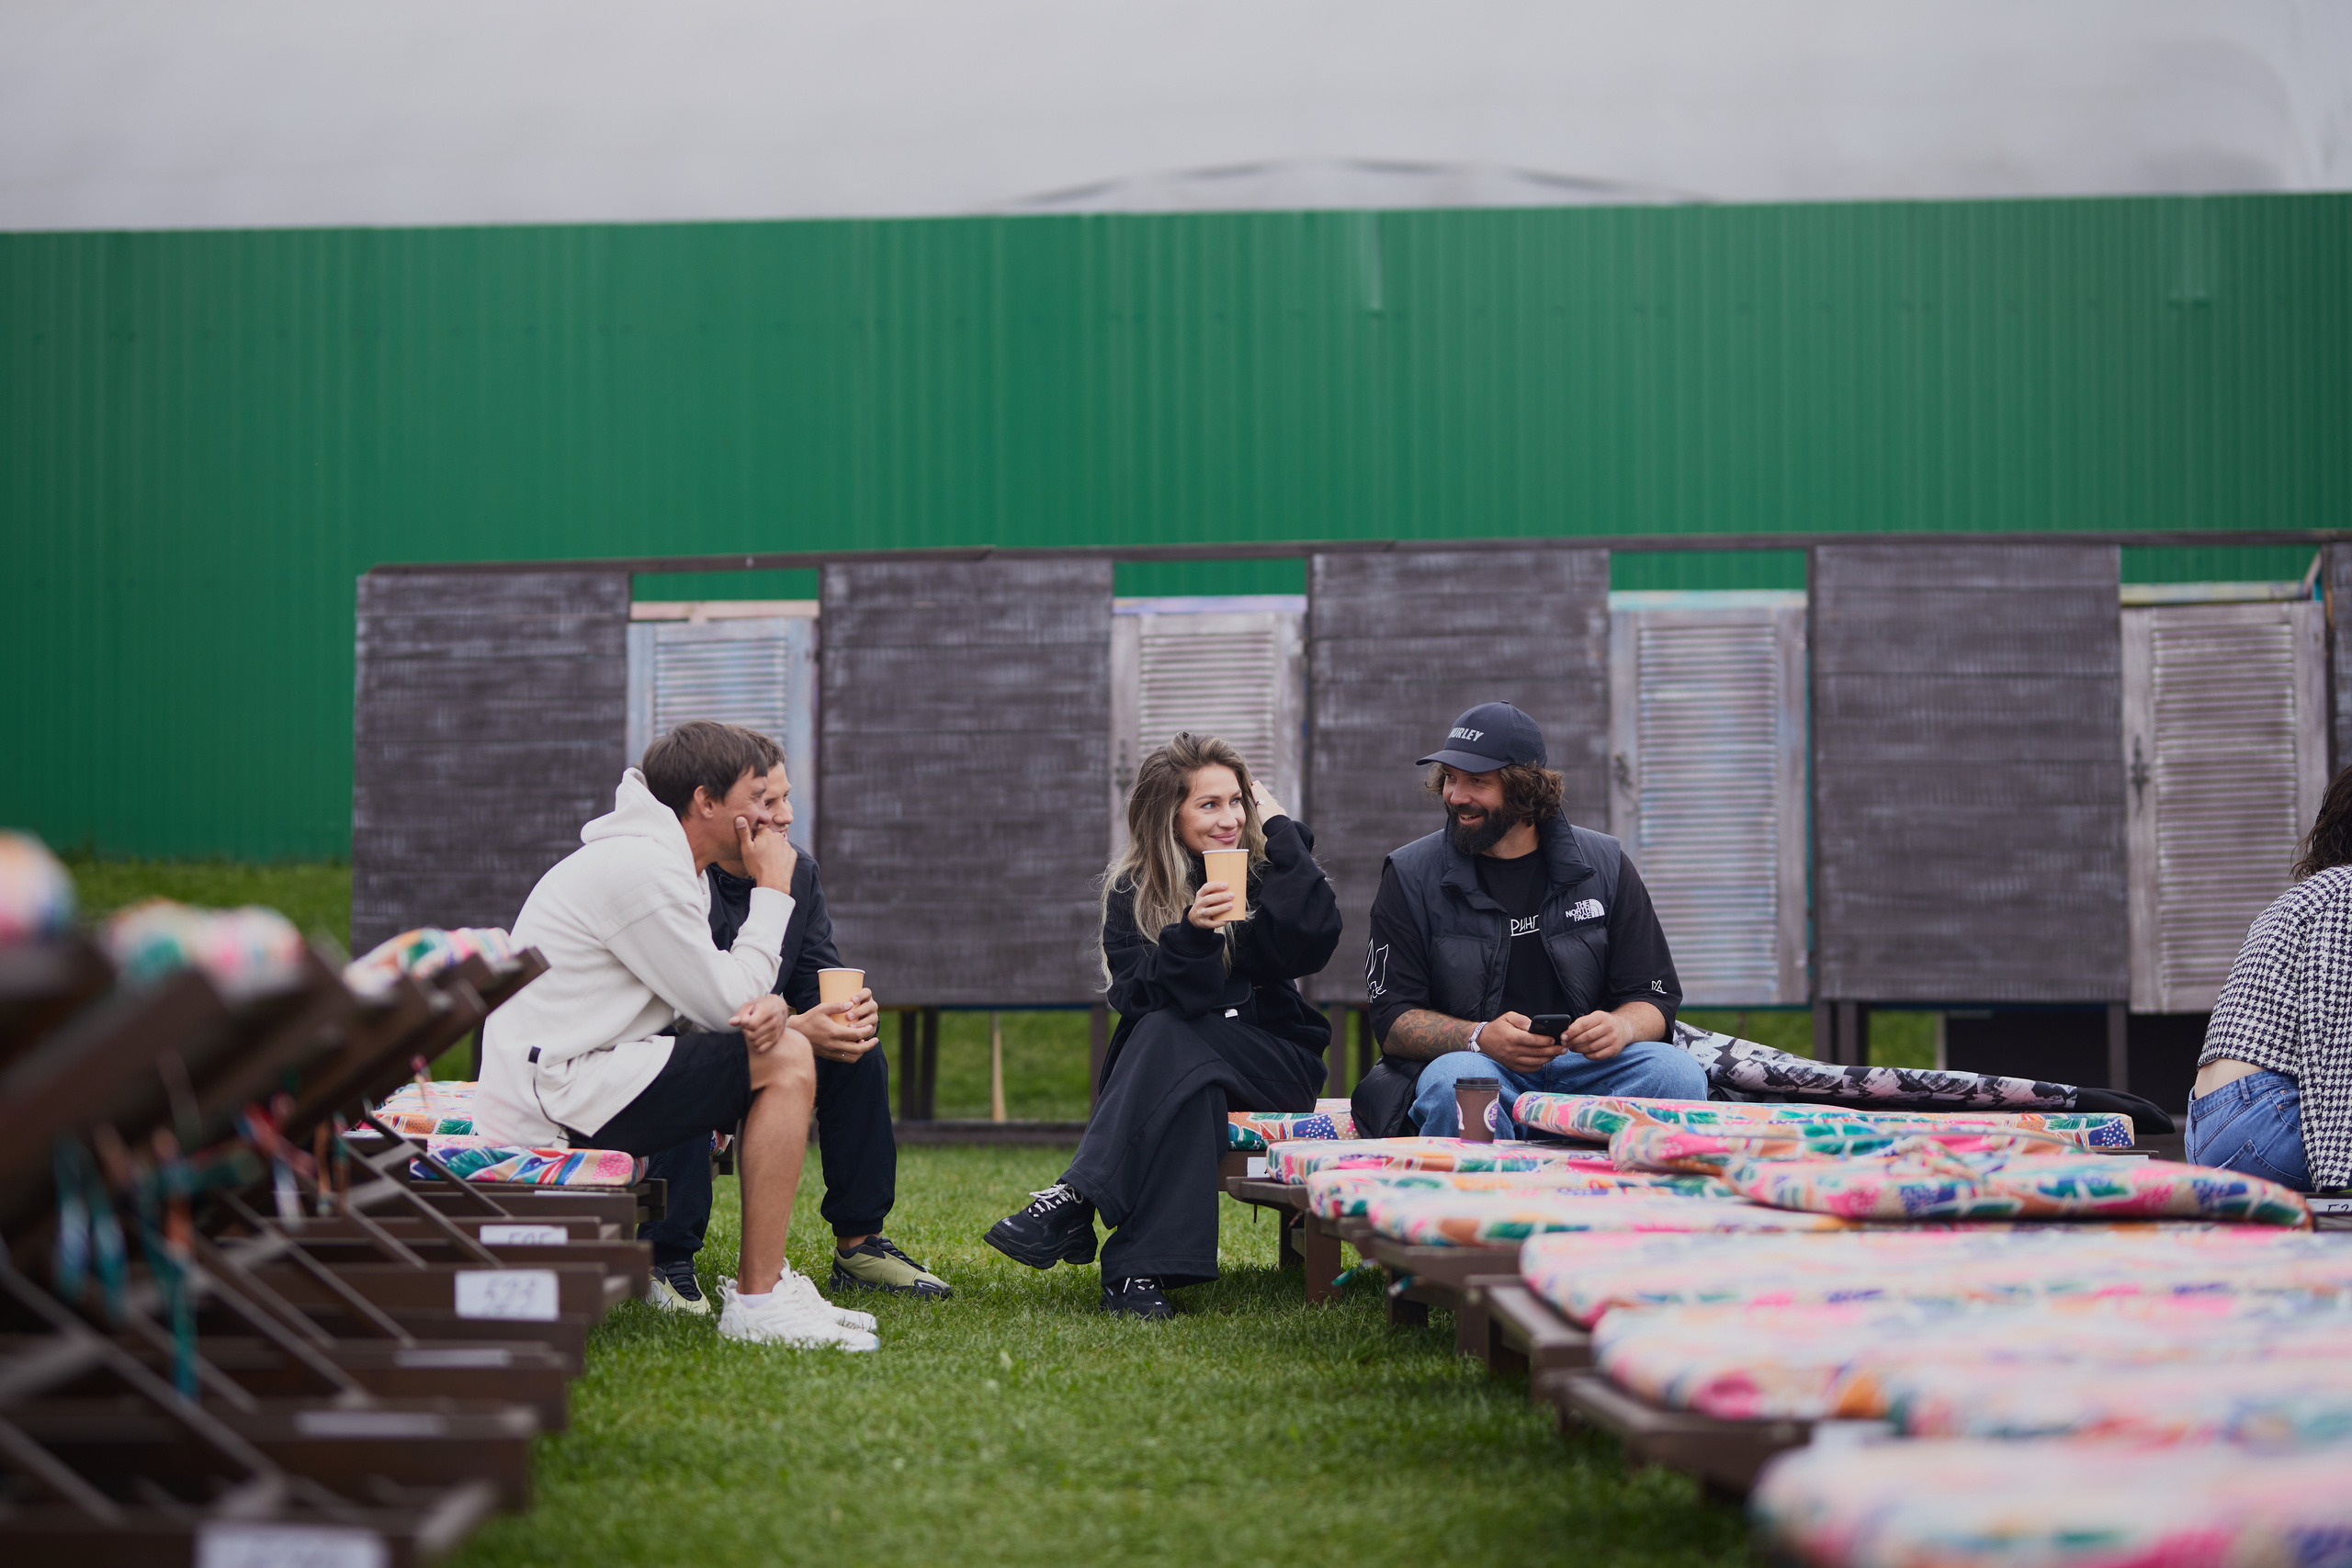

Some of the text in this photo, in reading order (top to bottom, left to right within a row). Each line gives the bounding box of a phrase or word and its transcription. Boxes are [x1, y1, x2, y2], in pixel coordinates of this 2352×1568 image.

[1574, 899, 1589, 909] THE
[1565, 906, 1590, 918] NORTH
[1574, 912, 1592, 922] FACE
